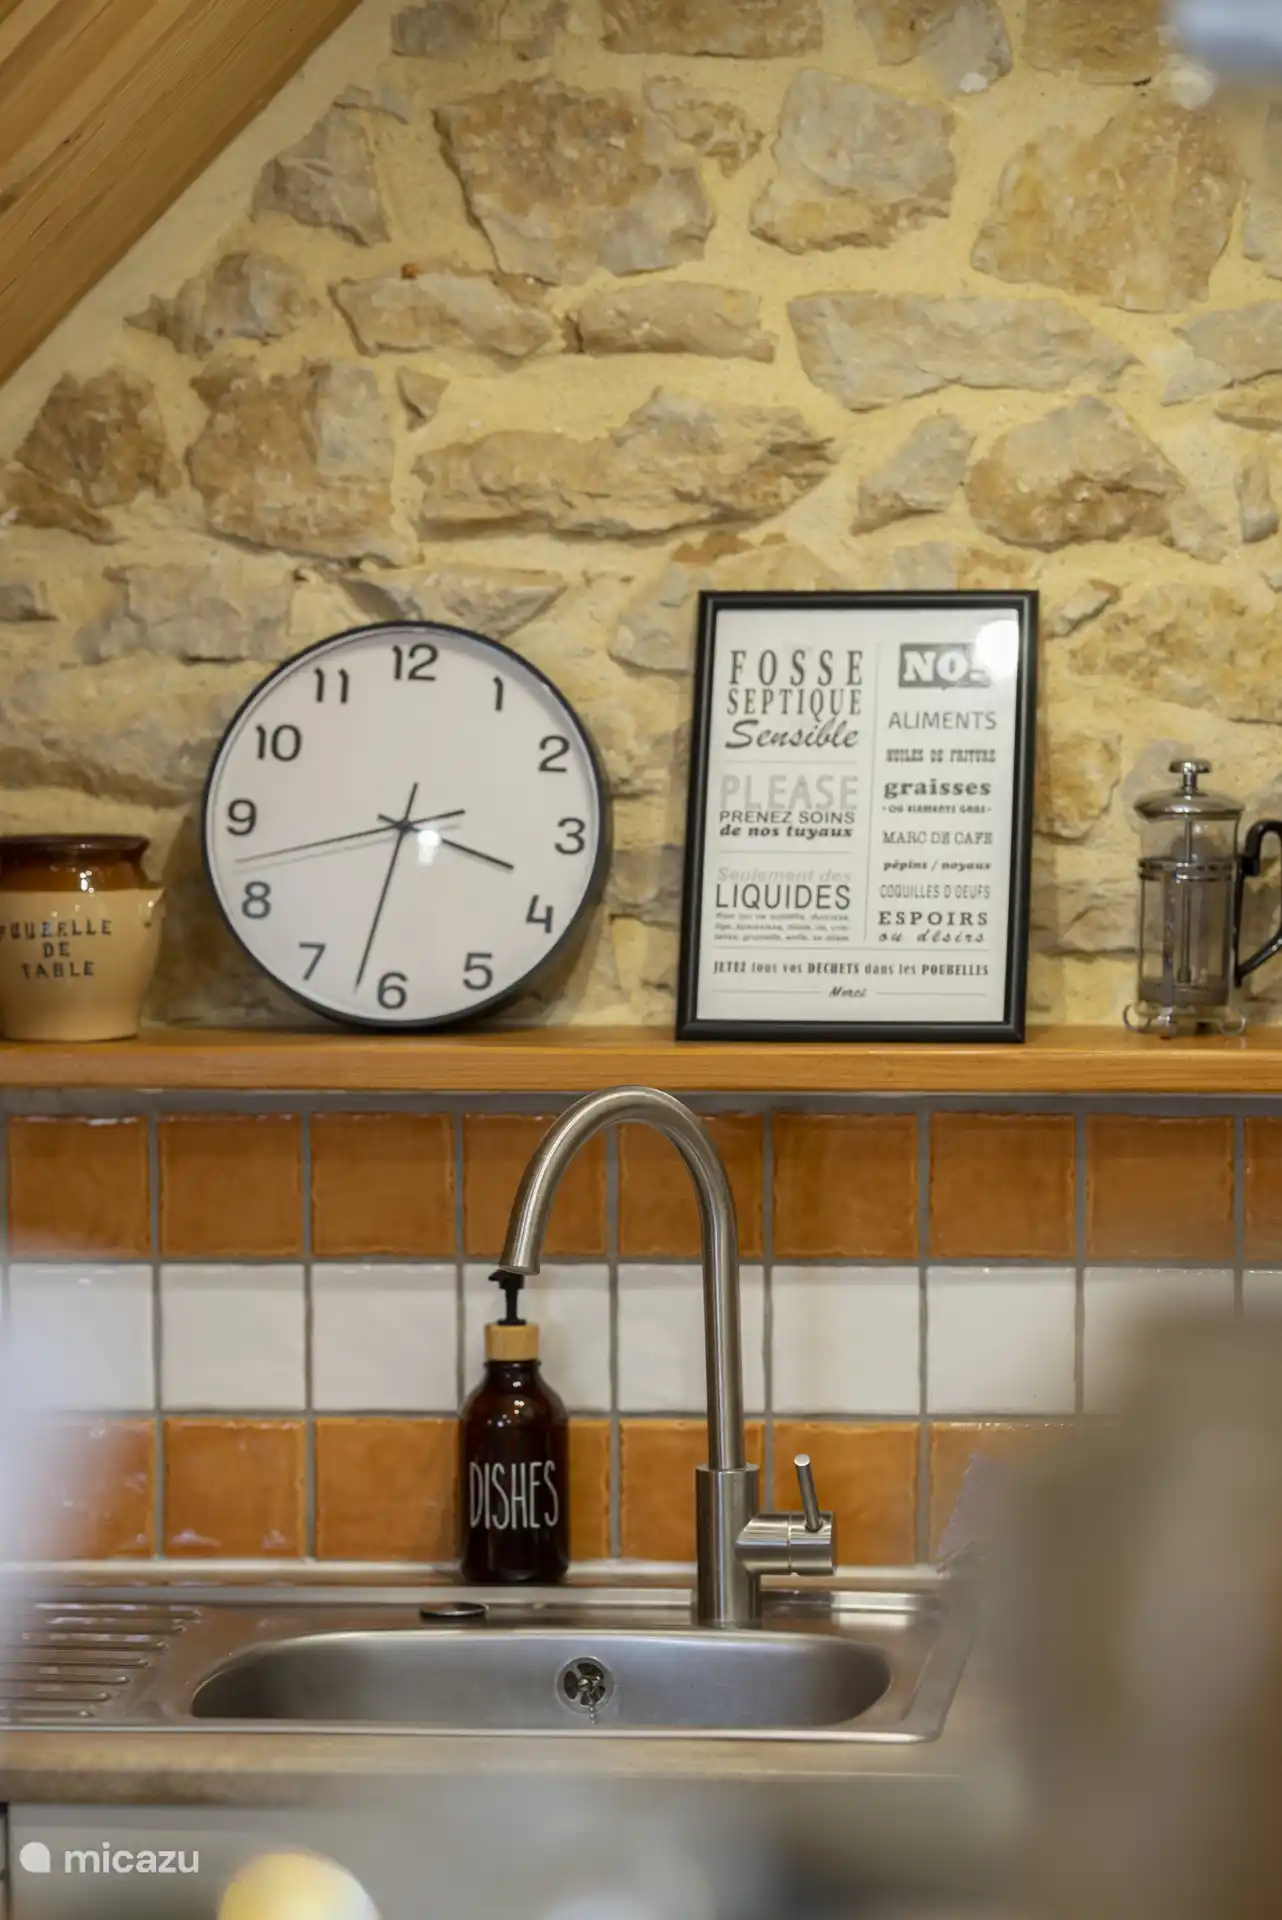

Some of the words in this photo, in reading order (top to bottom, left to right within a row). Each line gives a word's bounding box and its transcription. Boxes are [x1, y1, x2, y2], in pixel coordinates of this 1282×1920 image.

[391, 642, 439, 682] 12
[728, 649, 863, 686] FOSSE
[901, 647, 991, 686] NO
[313, 667, 349, 704] 11
[493, 676, 504, 712] 1
[726, 688, 862, 722] SEPTIQUE
[888, 711, 997, 730] ALIMENTS
[255, 723, 302, 762] 10
[724, 718, 859, 749] Sensible
[537, 735, 571, 773] 2
[719, 774, 859, 811] PLEASE
[884, 778, 992, 799] graisses
[226, 798, 257, 836] 9
[719, 810, 792, 824] PRENEZ
[798, 811, 856, 825] SOINS
[719, 824, 741, 837] de
[748, 826, 780, 838] nos
[786, 825, 853, 840] tuyaux
[554, 817, 586, 855] 3
[882, 831, 927, 844] MARC
[241, 881, 272, 919] 8
[715, 883, 851, 910] LIQUIDES
[879, 884, 940, 899] COQUILLES
[525, 894, 555, 934] 4
[878, 910, 988, 925] ESPOIRS
[43, 942, 70, 958] DE
[298, 941, 326, 981] 7
[21, 960, 95, 980] TABLE
[462, 952, 494, 991] 5
[377, 972, 408, 1010] 6
[470, 1460, 559, 1530] DISHES
